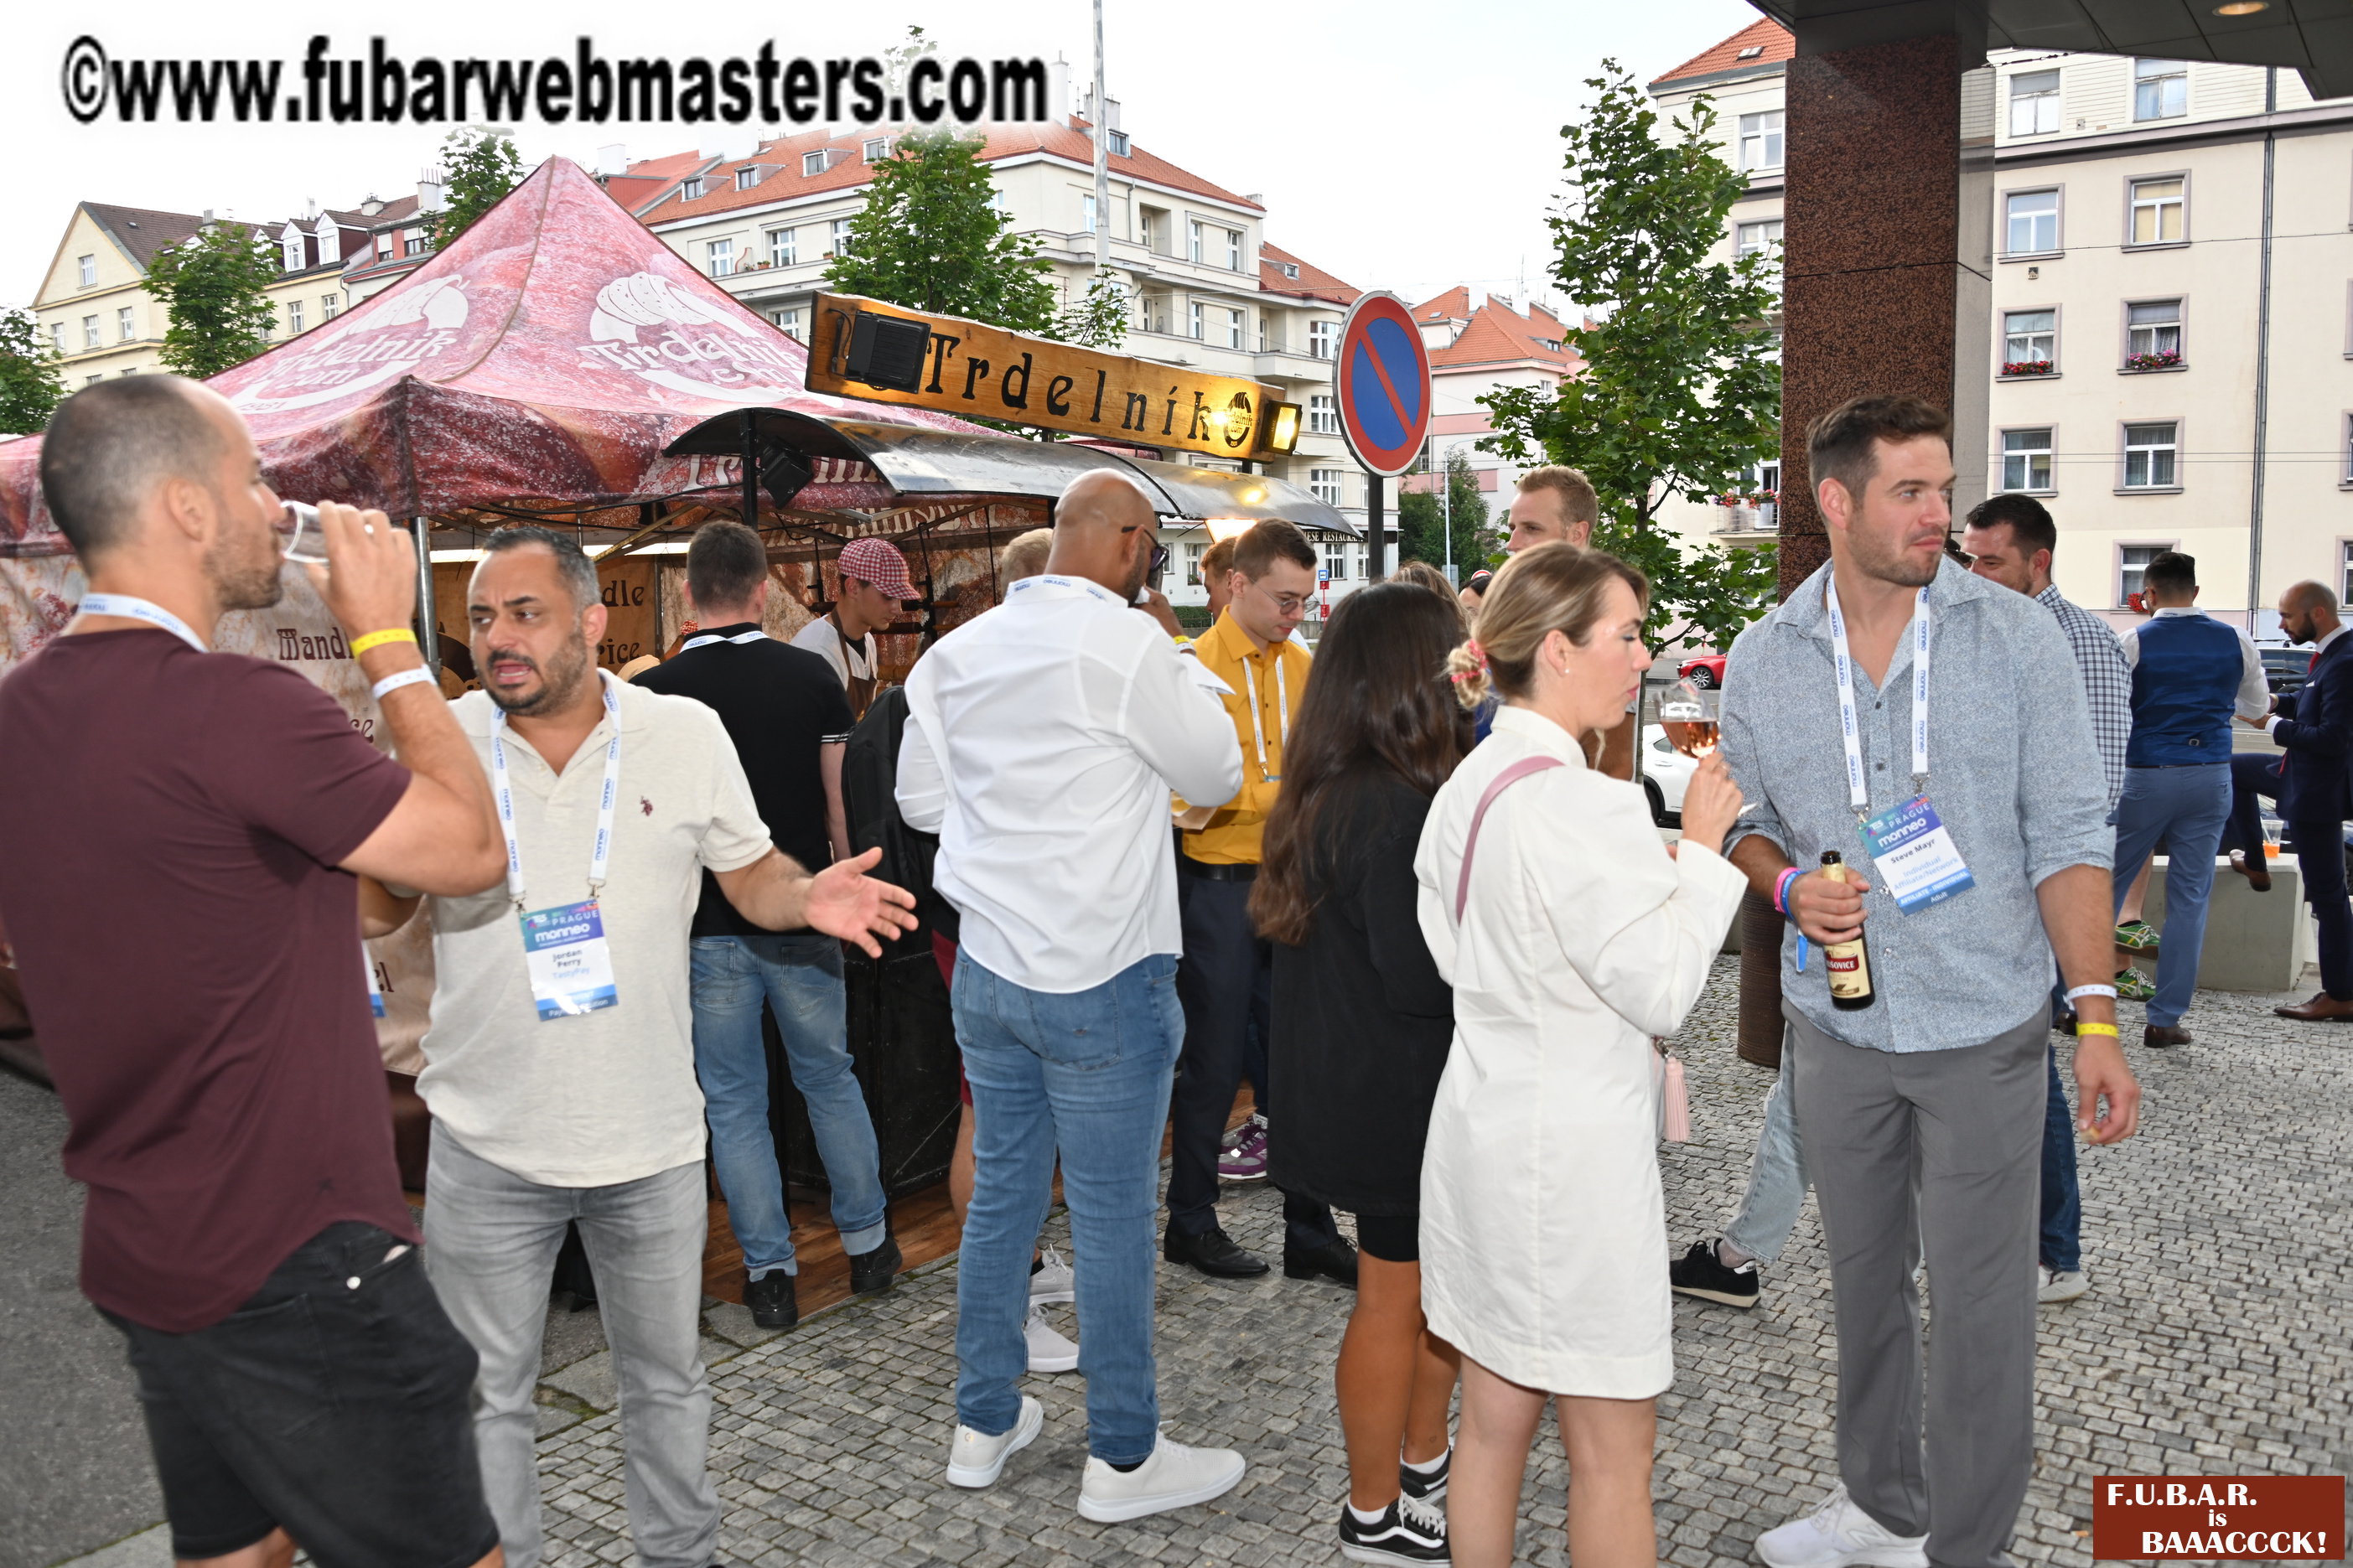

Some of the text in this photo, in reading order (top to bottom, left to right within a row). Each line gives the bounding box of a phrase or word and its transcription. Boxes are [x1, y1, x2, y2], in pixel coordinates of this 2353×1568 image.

[925, 332, 1212, 442] Trdelník
[601, 580, 645, 607] dle
[1830, 610, 1839, 638] monneo
[277, 627, 355, 660] Mandl
[1837, 655, 1845, 686] monneo
[1843, 705, 1852, 736] monneo
[1848, 755, 1858, 787] monneo
[602, 779, 611, 810] monneo
[1888, 803, 1931, 828] PRAGUE
[595, 829, 604, 861] monneo
[1878, 817, 1927, 848] monneo
[1890, 838, 1936, 864] Steve Mayr
[1894, 856, 1959, 890] Affiliate/Network
[1903, 856, 1941, 877] Individual
[1900, 887, 1930, 905] AFFILIATE
[1931, 871, 1968, 892] INDIVIDUAL
[1931, 891, 1948, 903] Adult
[552, 909, 599, 926] PRAGUE
[535, 923, 590, 943] monneo
[552, 949, 583, 962] Jordan
[557, 958, 582, 968] Perry
